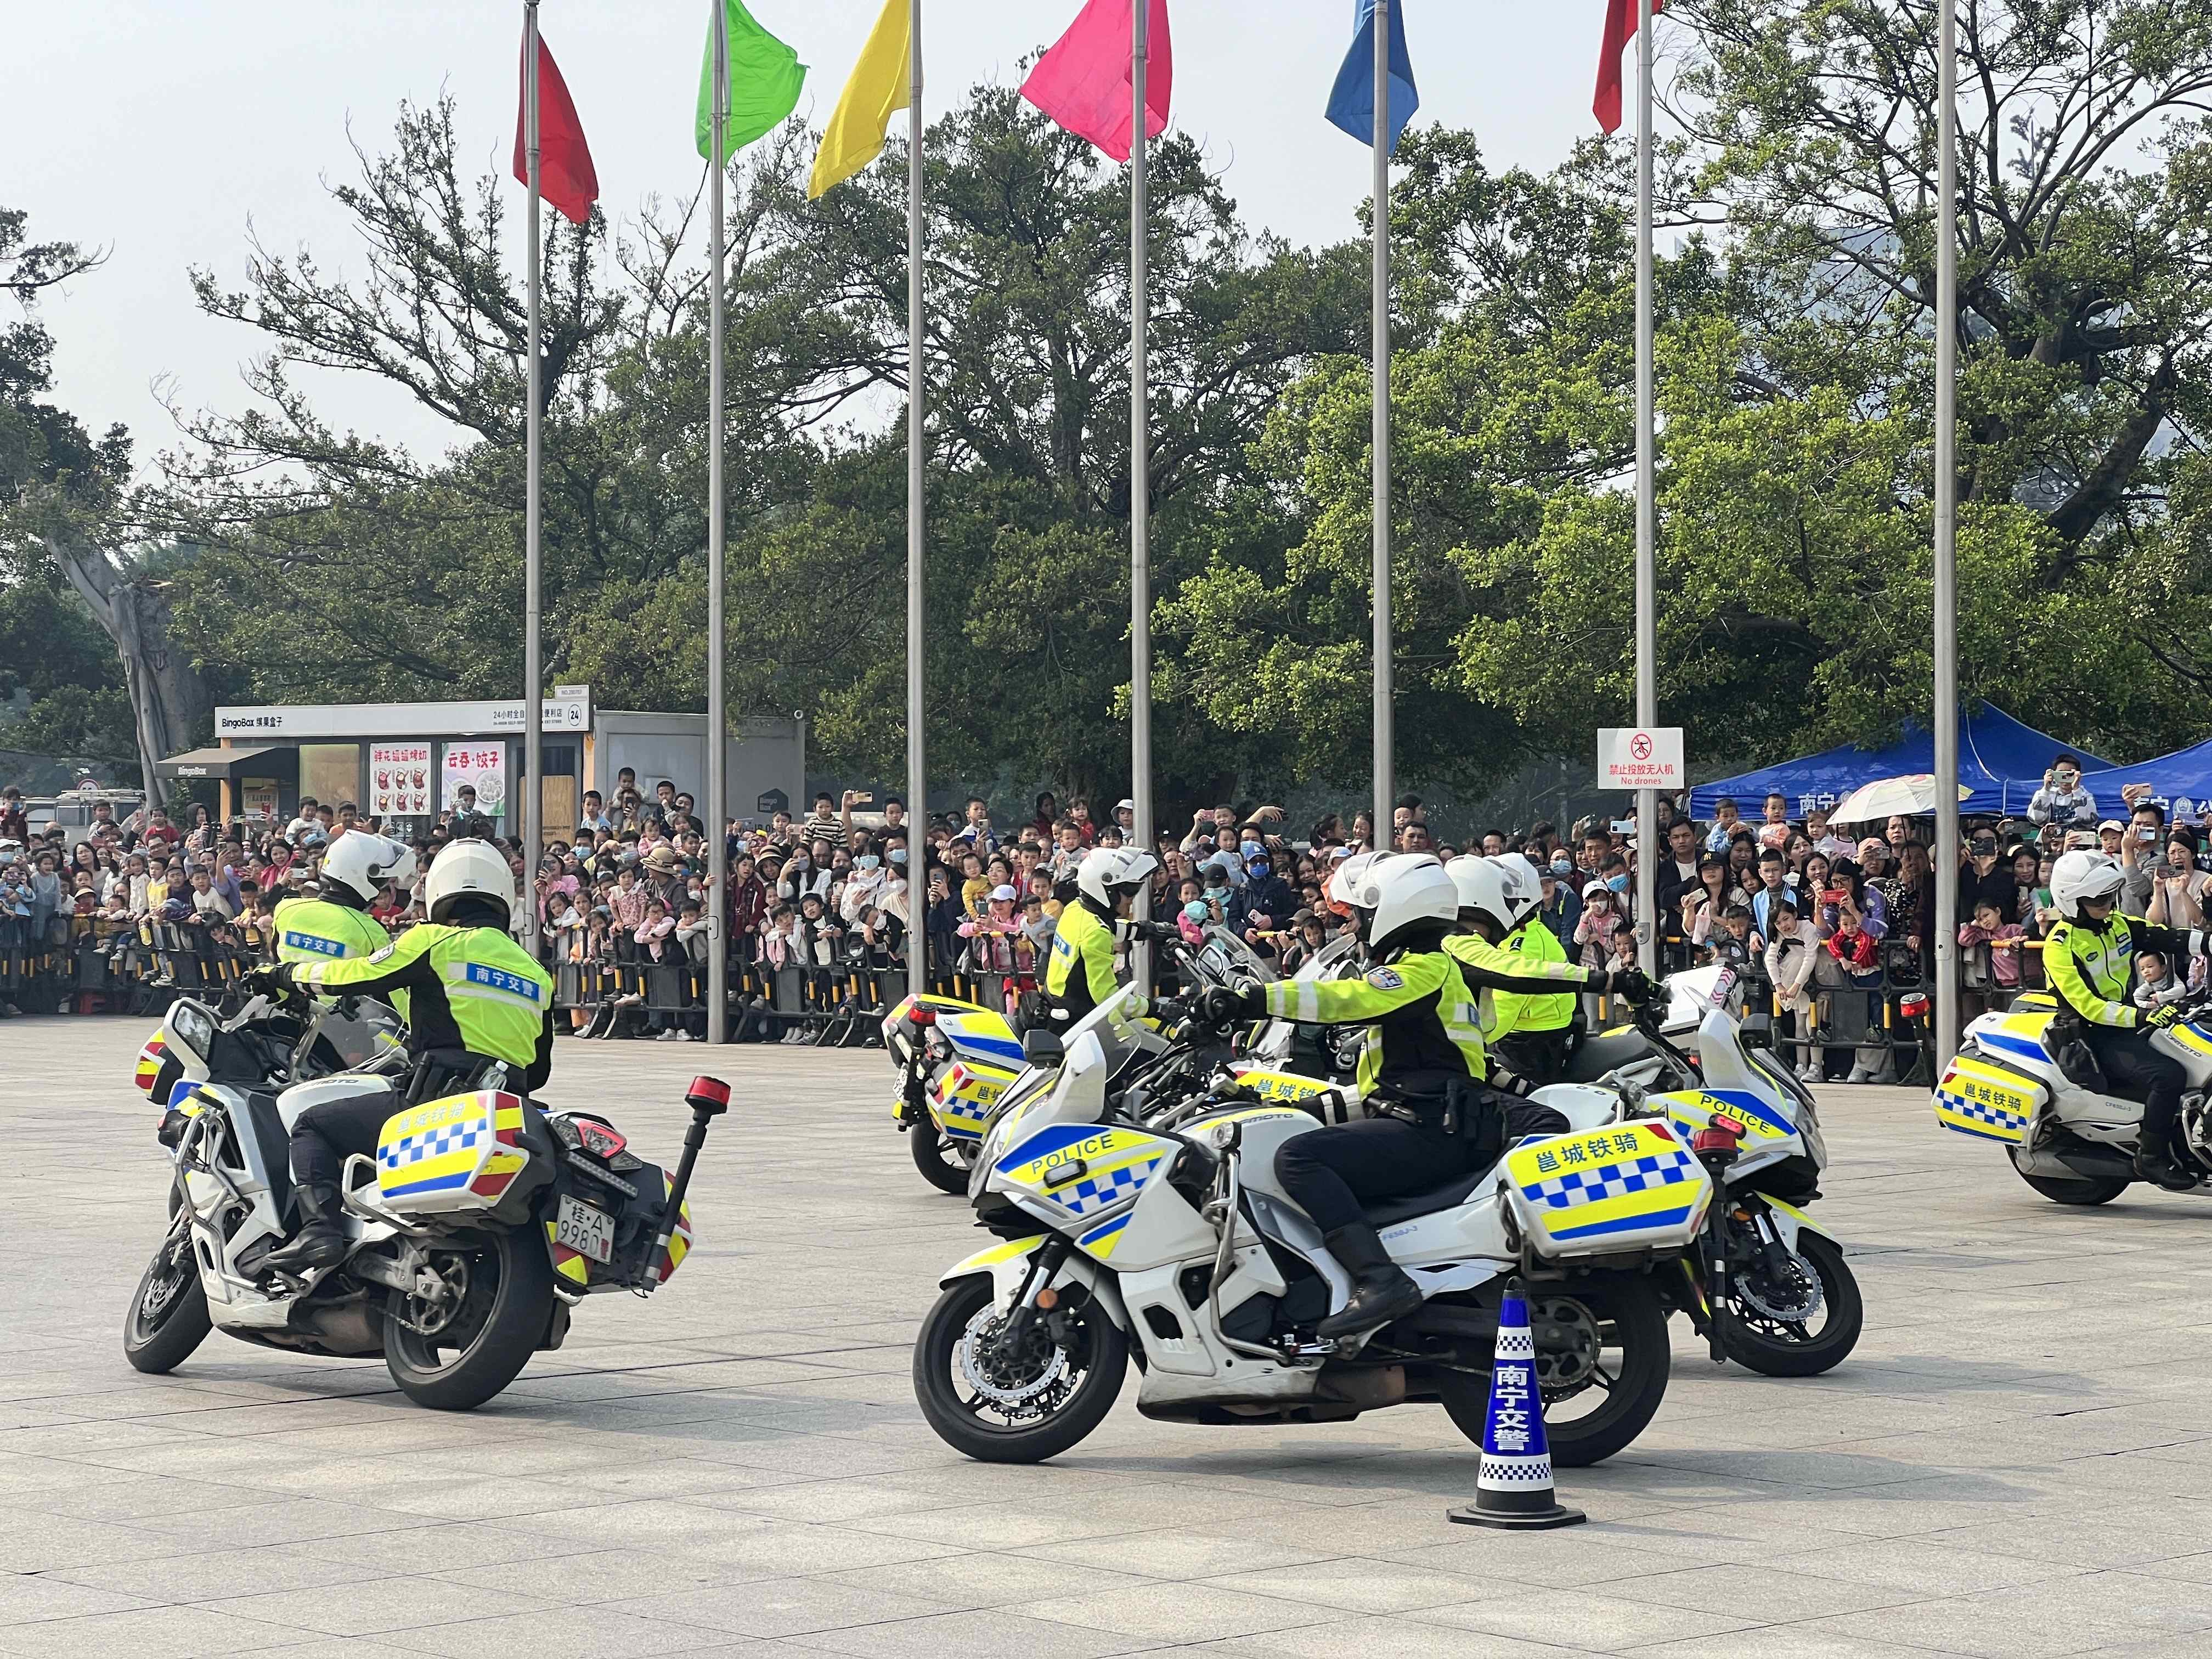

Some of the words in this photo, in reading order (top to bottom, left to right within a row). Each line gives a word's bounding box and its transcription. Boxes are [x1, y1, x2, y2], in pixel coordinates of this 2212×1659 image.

[222, 717, 254, 729] BingoBox
[256, 716, 283, 727] 缤果盒子
[493, 708, 562, 719] 24小时全自便利店
[571, 710, 579, 720] 24
[178, 766, 207, 776] BingoBox
[1609, 764, 1674, 775] 禁止投放无人机
[1798, 792, 1835, 815] 南宁
[290, 934, 338, 955] 南宁交警
[476, 967, 534, 997] 南宁交警
[1255, 1079, 1317, 1099] 邕城铁
[1965, 1082, 2022, 1111] 邕城铁骑
[1700, 1094, 1774, 1135] POLICE
[1031, 1133, 1115, 1175] POLICE
[1536, 1132, 1638, 1173] 邕城铁骑
[1493, 1365, 1530, 1451] 南宁交警
